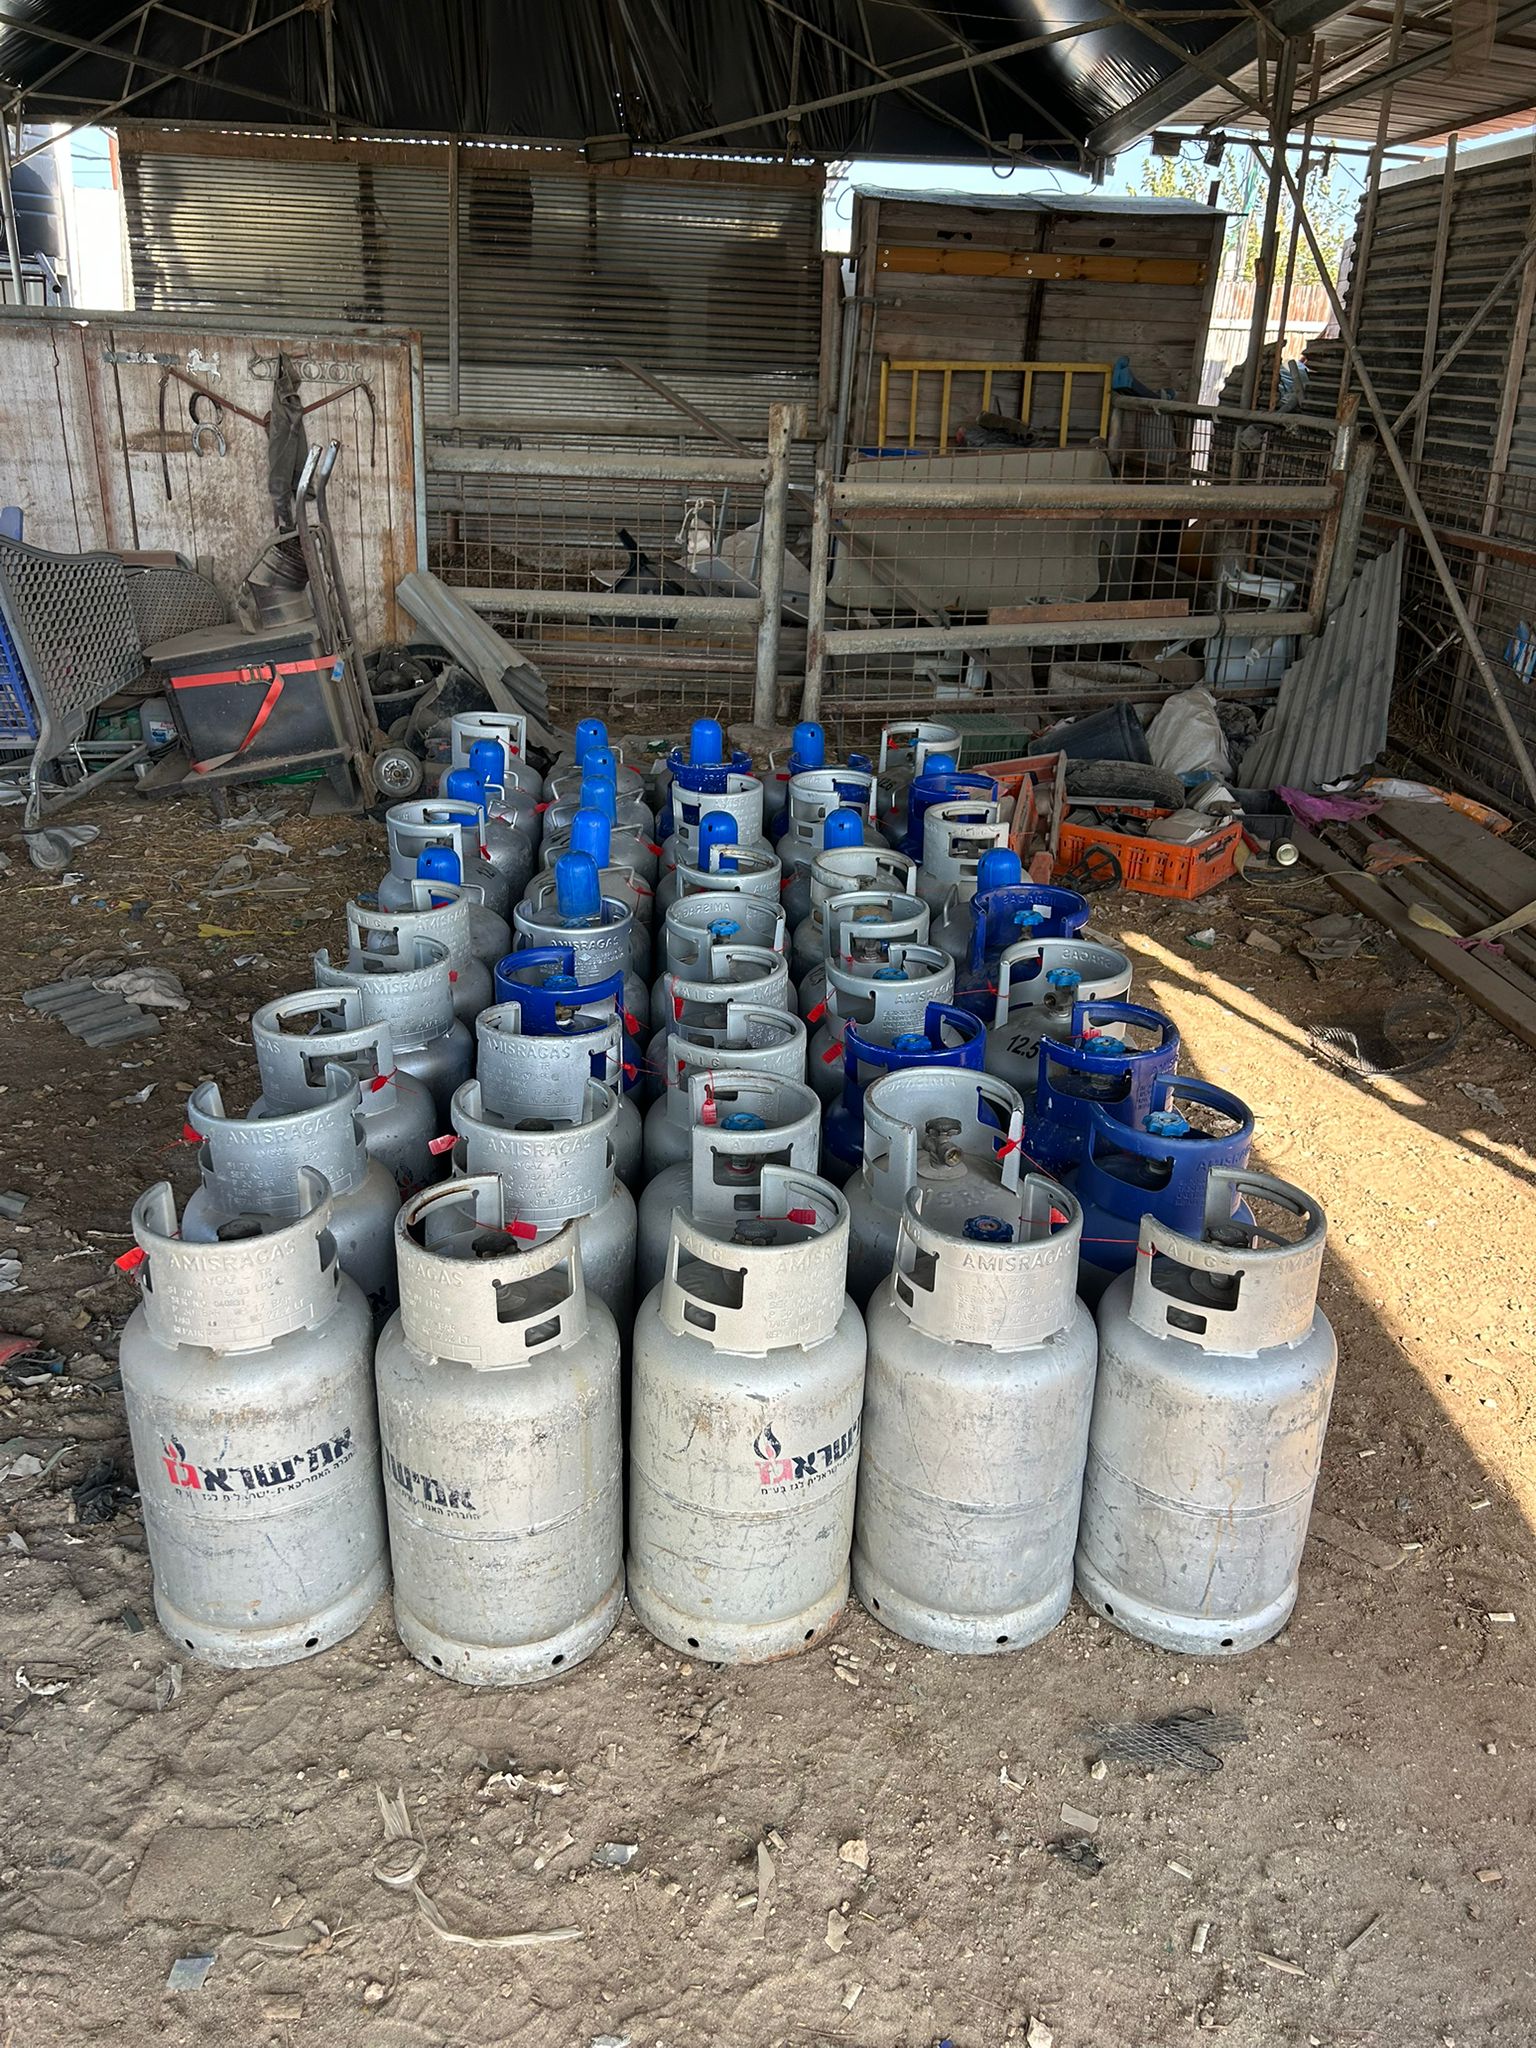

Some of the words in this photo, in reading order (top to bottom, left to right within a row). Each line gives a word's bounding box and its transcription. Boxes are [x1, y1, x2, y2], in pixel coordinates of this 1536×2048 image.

[1006, 1034, 1040, 1059] 12.5
[227, 1113, 335, 1146] AMISRAGAS
[484, 1135, 592, 1158] AMISRAGAS
[168, 1239, 297, 1272] AMISRAGAS
[961, 1240, 1072, 1273] AMISRAGAS
